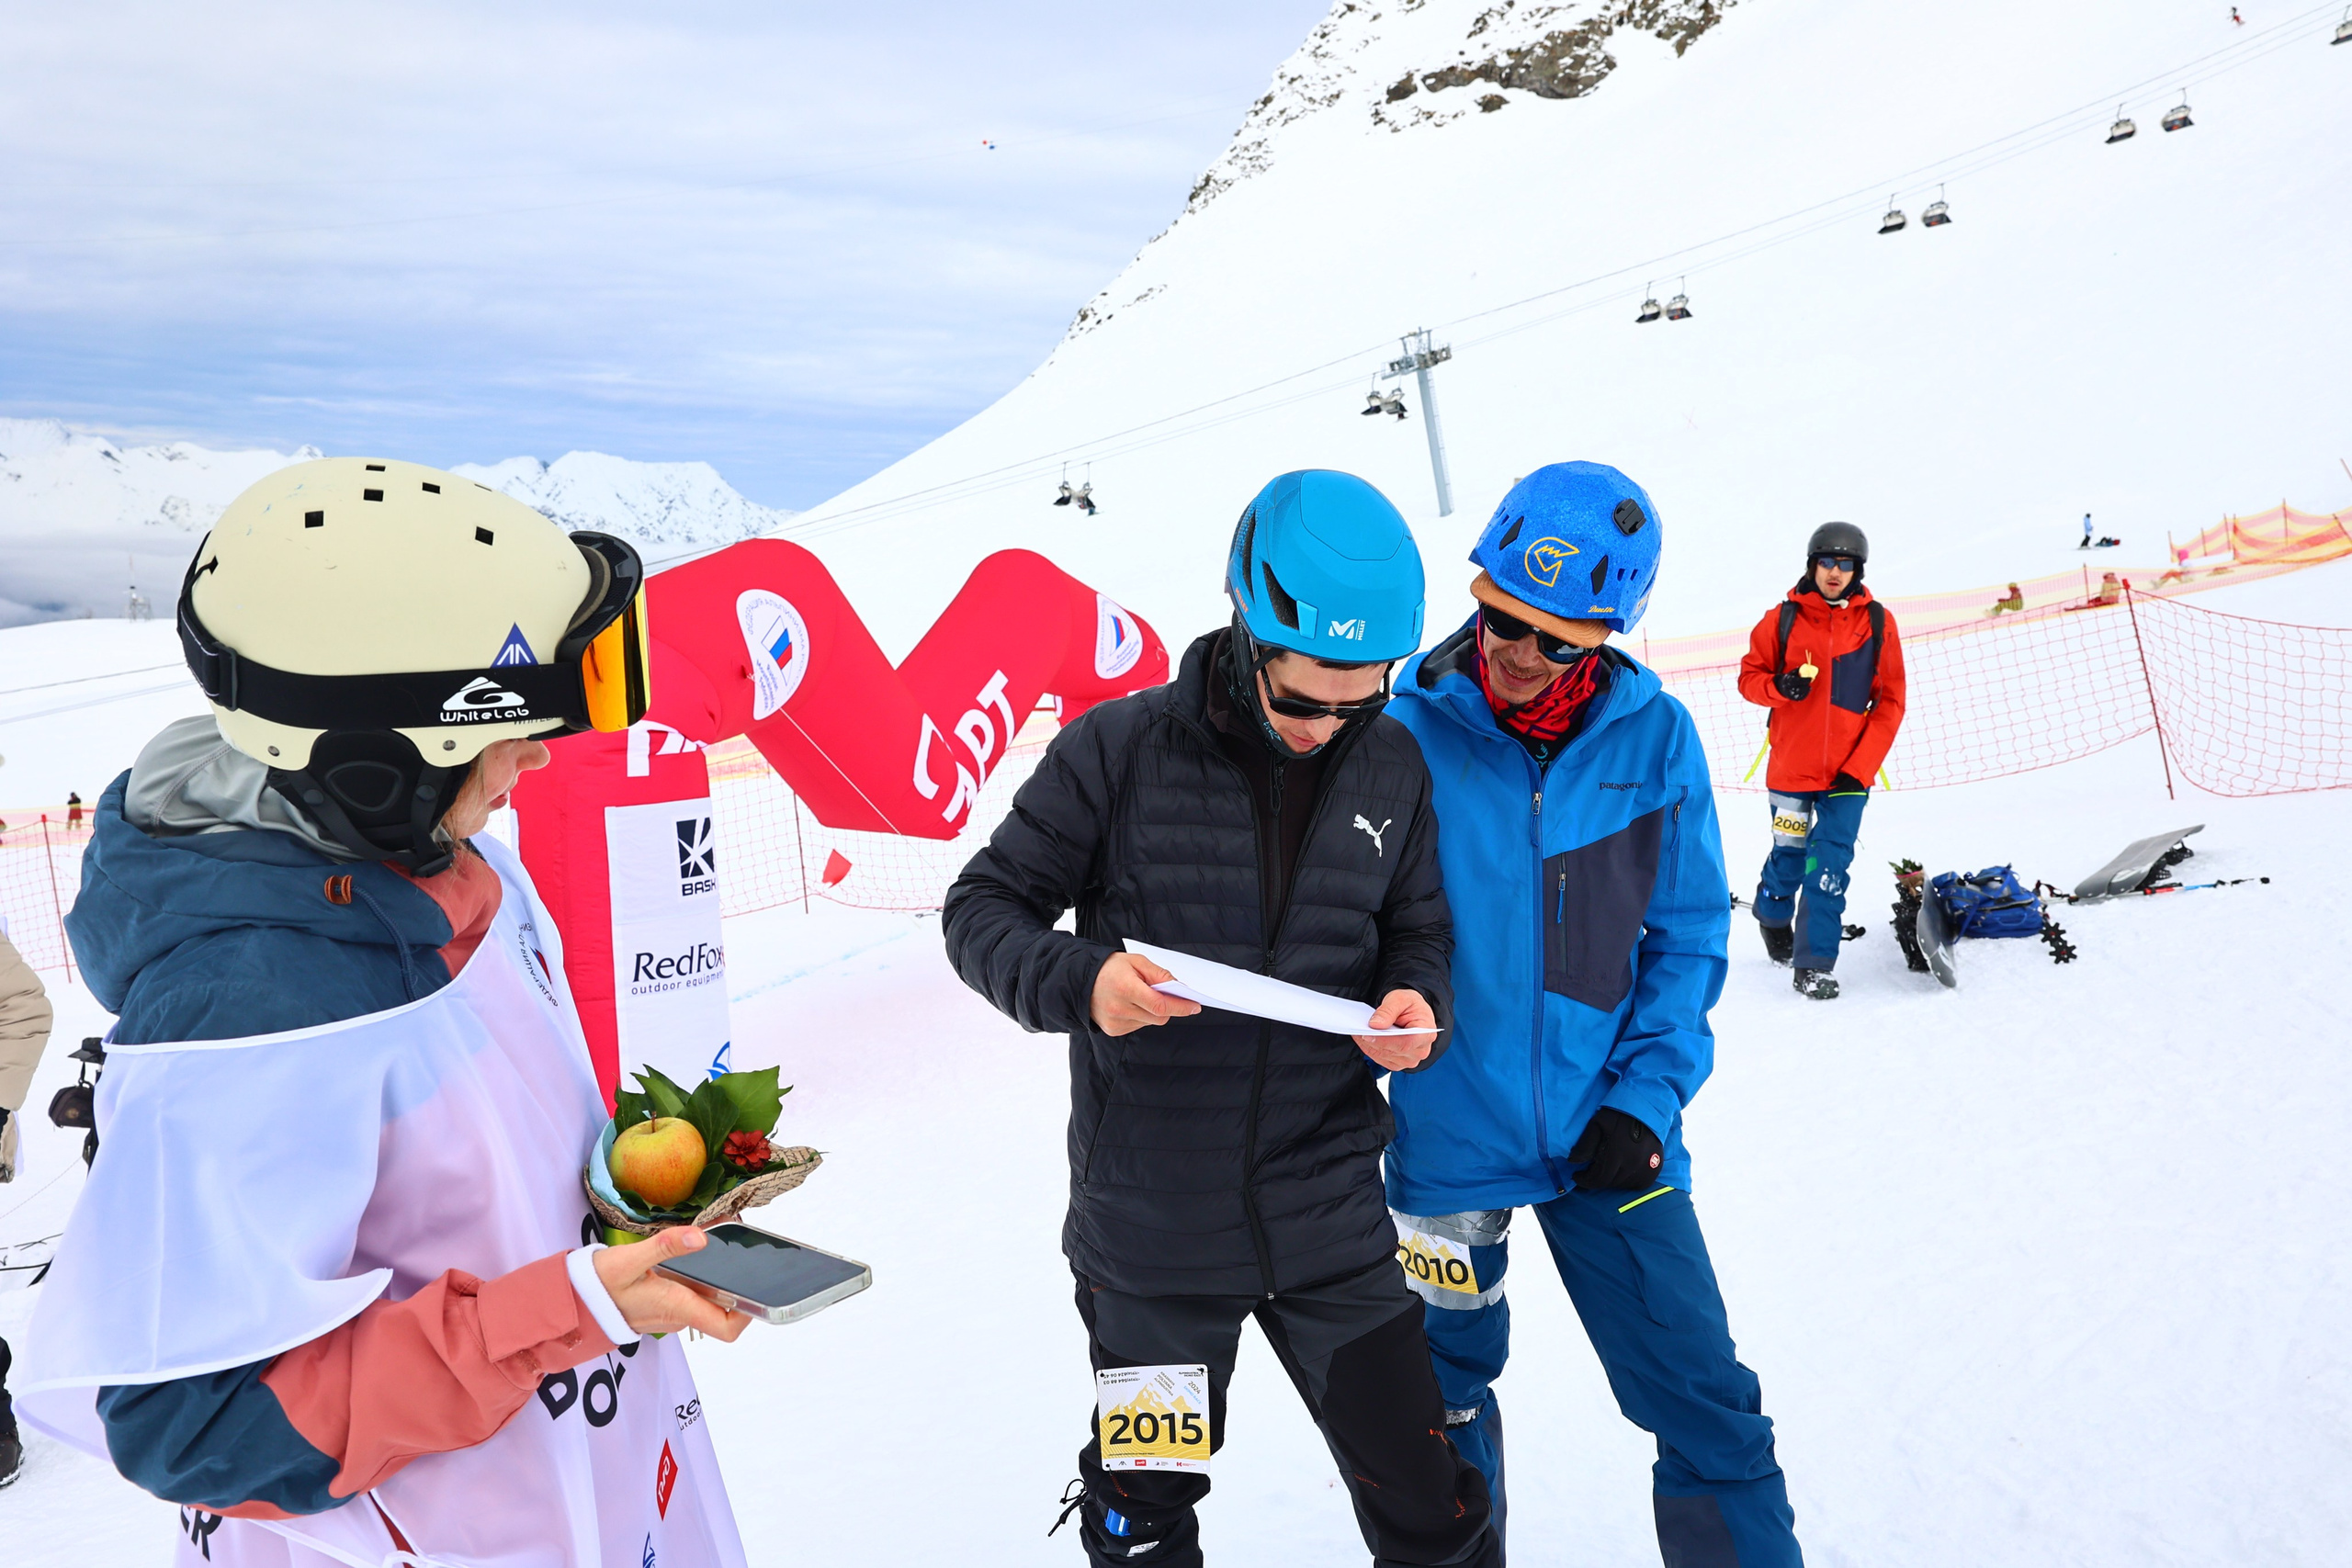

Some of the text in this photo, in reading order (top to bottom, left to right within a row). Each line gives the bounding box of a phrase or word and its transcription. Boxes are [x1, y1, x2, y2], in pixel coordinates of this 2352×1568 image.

[1357, 619, 1366, 641] MILLET
[1774, 816, 1808, 832] 2009
[632, 942, 723, 983] RedFox
[631, 982, 682, 996] outdoor
[1401, 1246, 1469, 1285] 2010
[1187, 1381, 1202, 1394] 2024
[1108, 1412, 1204, 1446] 2015
